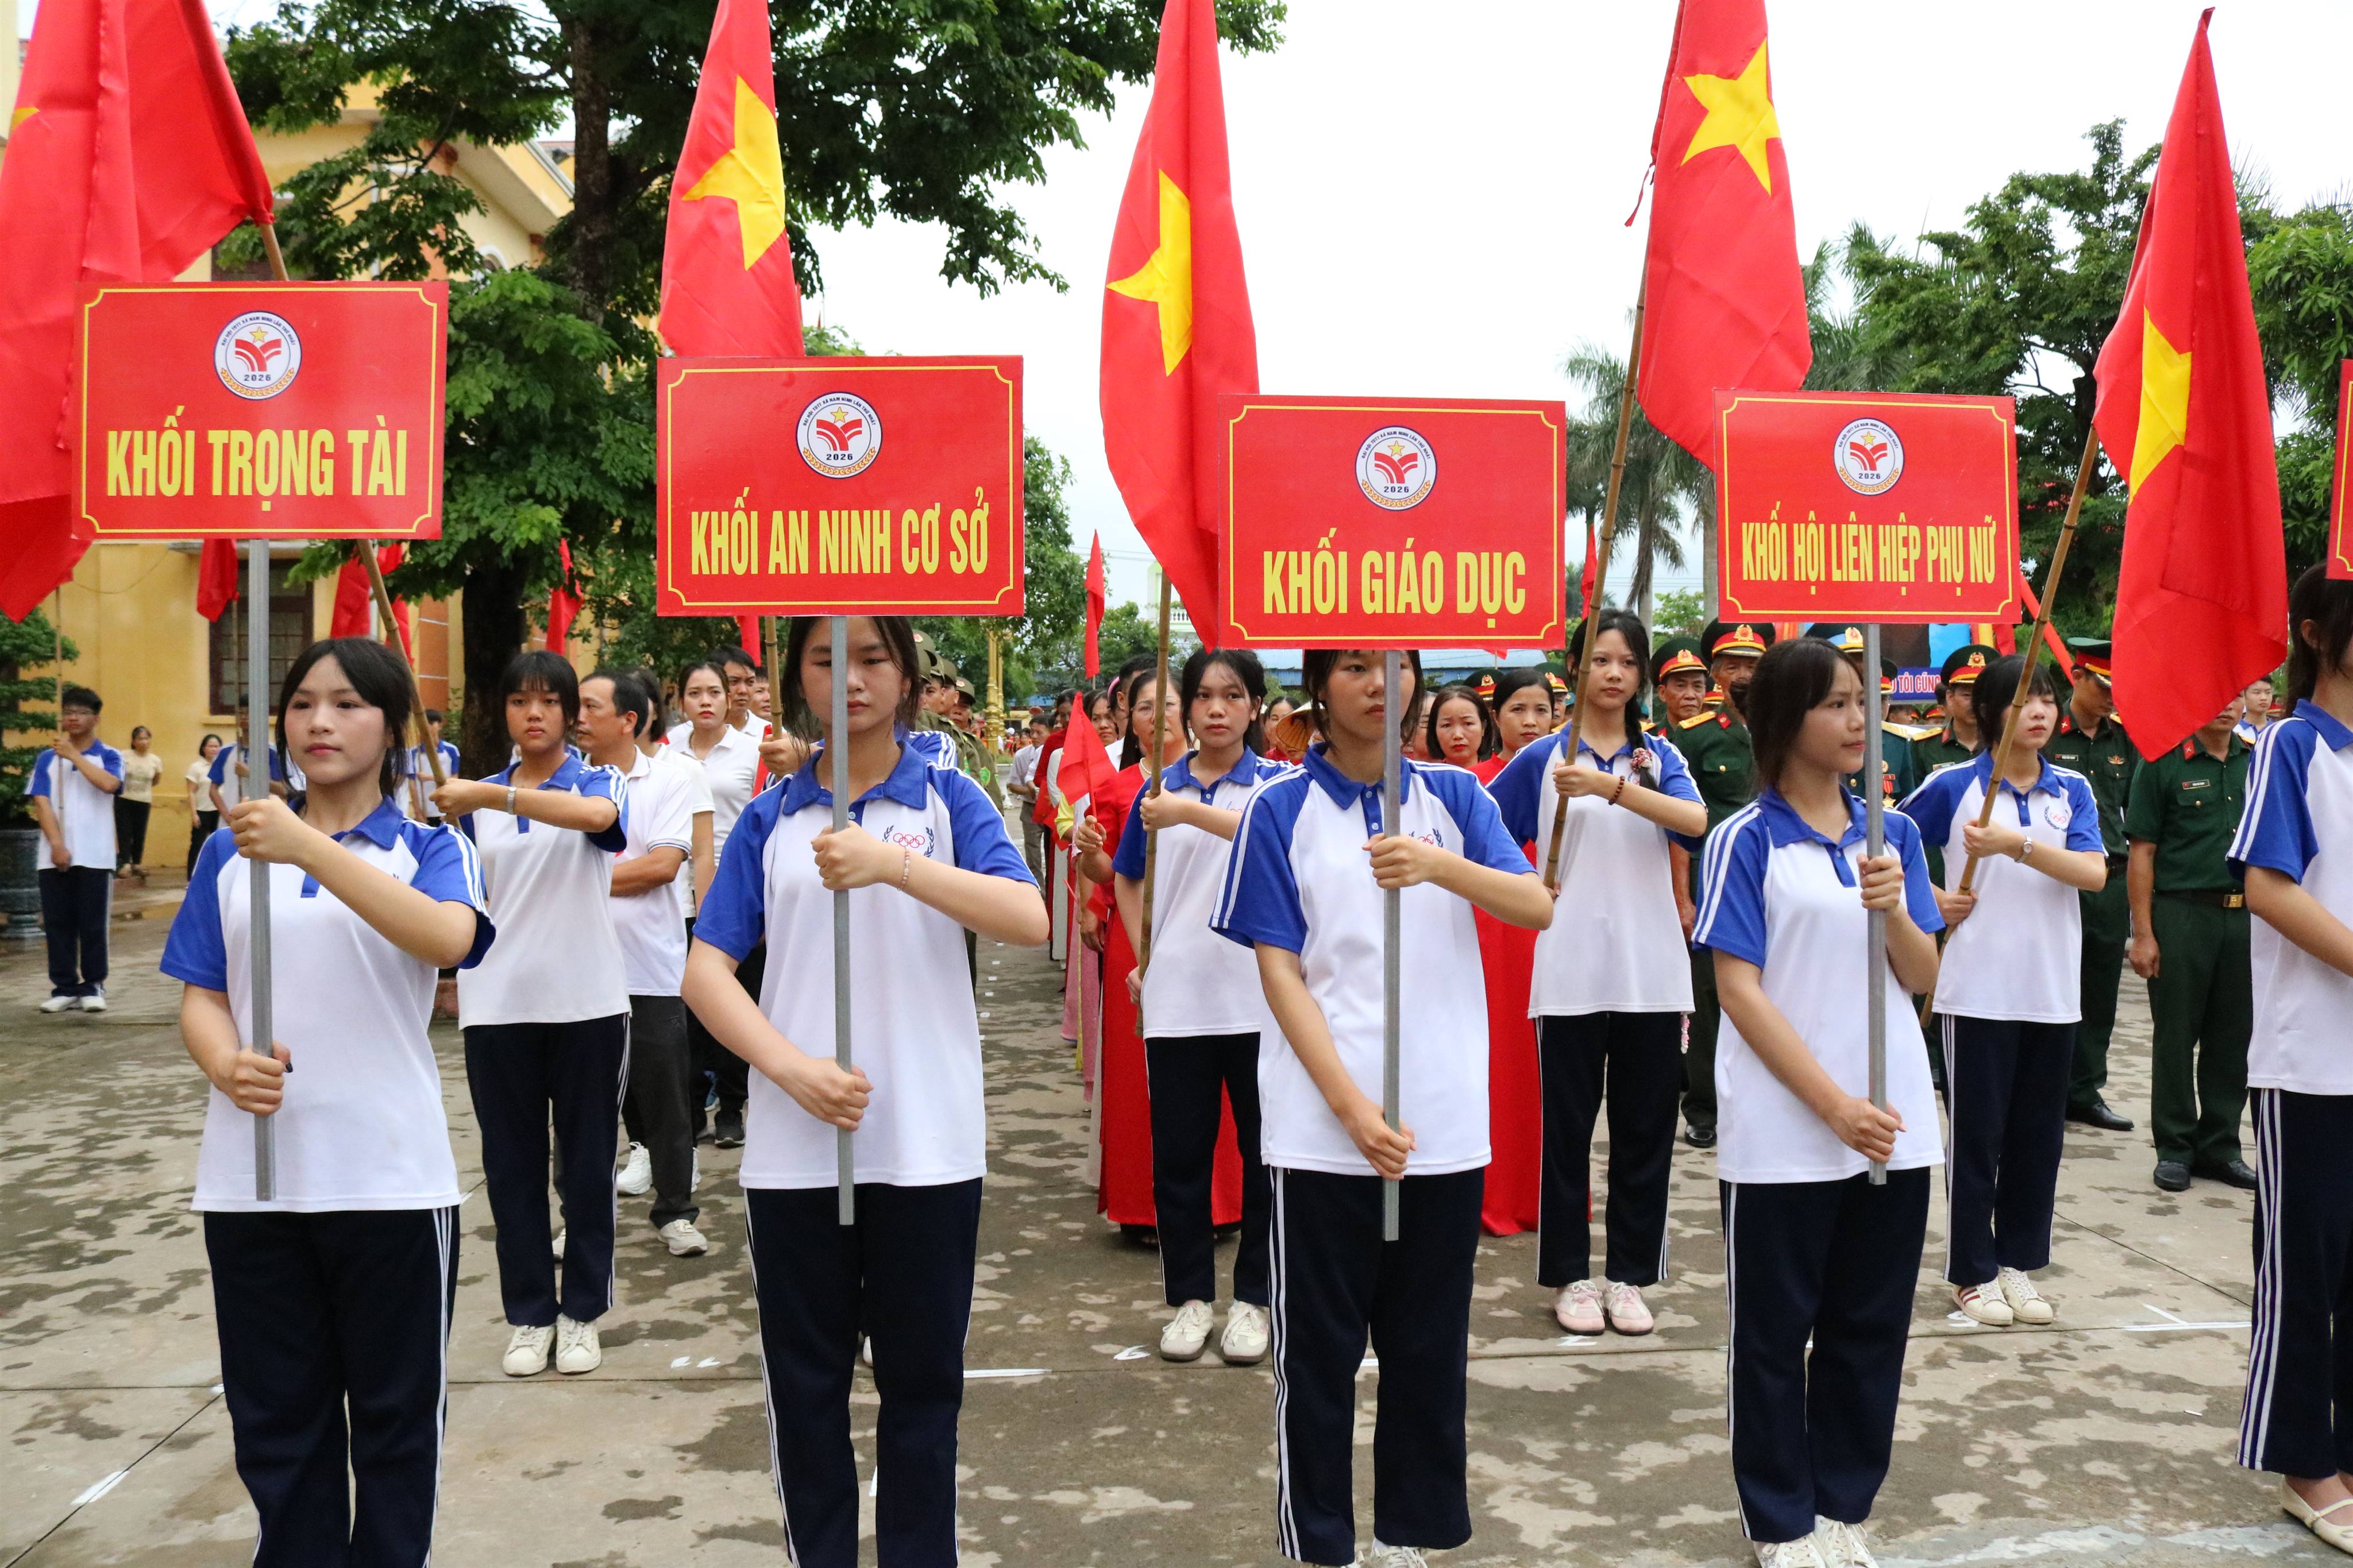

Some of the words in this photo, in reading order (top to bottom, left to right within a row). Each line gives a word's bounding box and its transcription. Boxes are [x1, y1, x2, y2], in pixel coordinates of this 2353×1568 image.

[812, 403, 821, 411] TDTT
[107, 405, 195, 496] KHỐI
[208, 430, 334, 511] TRỌNG
[348, 415, 407, 495] TÀI
[692, 487, 758, 575] KHỐI
[769, 511, 809, 574] AN
[819, 511, 890, 573] NINH
[902, 503, 940, 574] CƠ
[950, 486, 989, 574] SỞ
[1742, 501, 1787, 581] KHỐI
[1793, 511, 1825, 595] HỘI
[1831, 511, 1873, 581] LIÊN
[1879, 512, 1920, 596] HIỆP
[1927, 526, 1964, 596] PHỤ
[1969, 515, 1996, 584] NỮ
[1263, 527, 1348, 614] KHỐI
[1361, 537, 1444, 614] GIÁO
[1457, 552, 1526, 628] DỤC
[1897, 671, 1914, 693] TÔI
